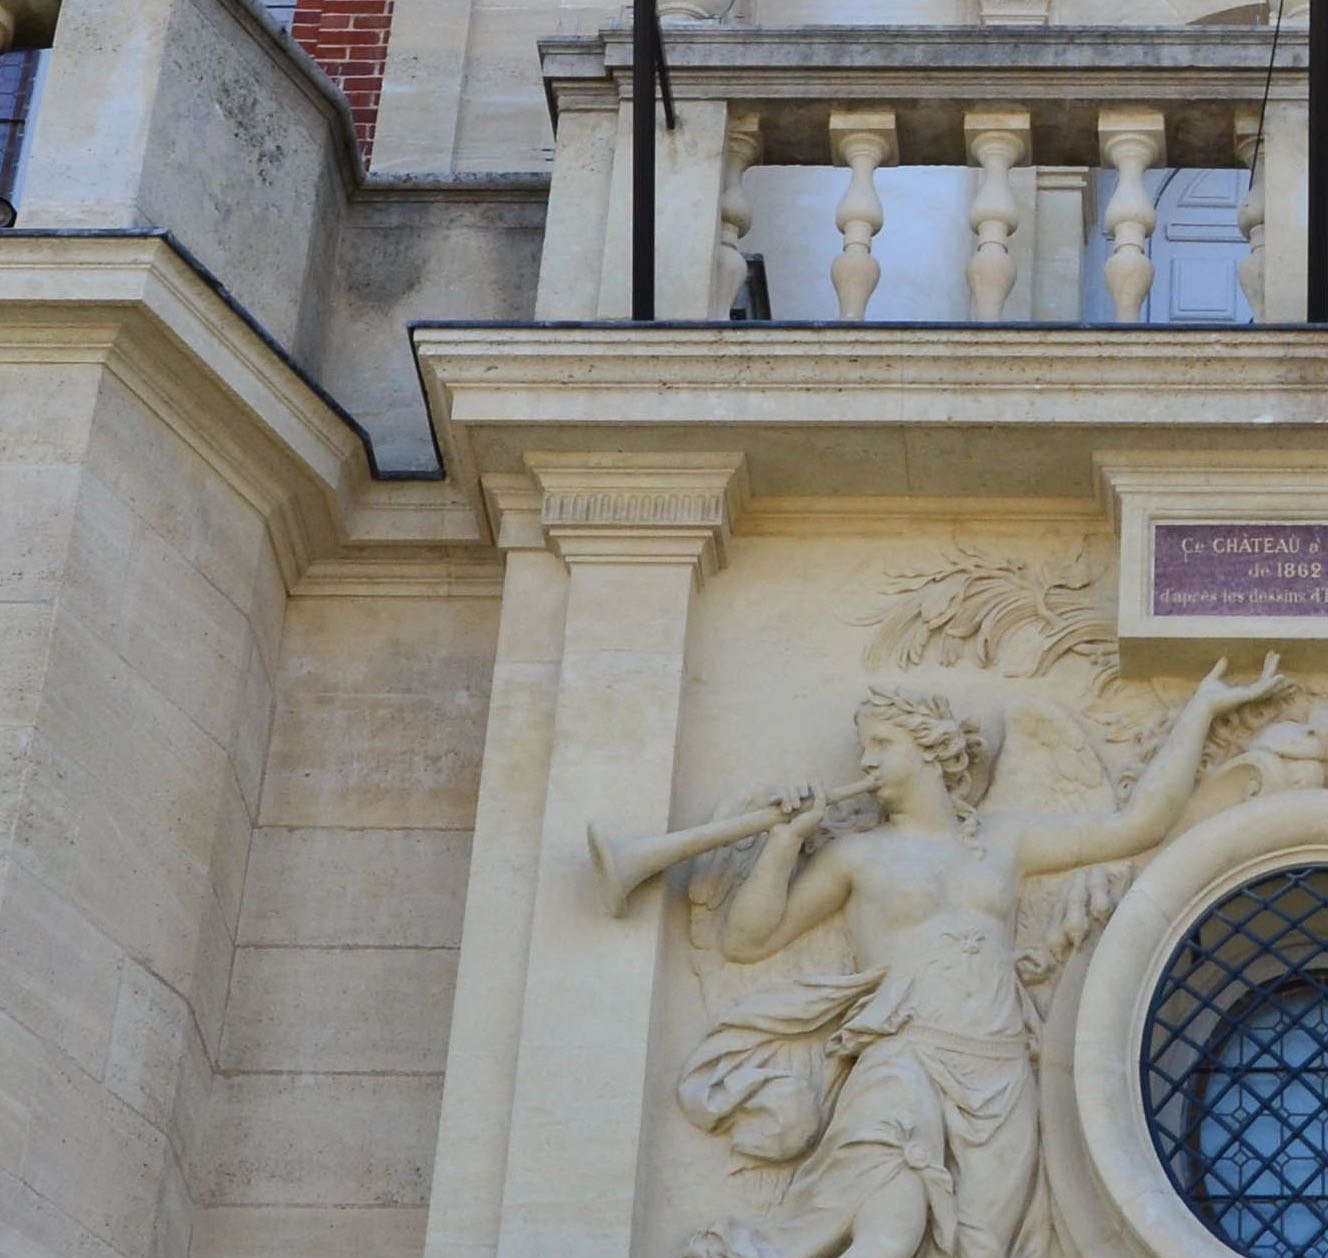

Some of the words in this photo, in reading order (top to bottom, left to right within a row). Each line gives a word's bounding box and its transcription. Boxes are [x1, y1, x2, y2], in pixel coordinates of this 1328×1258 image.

[1212, 533, 1301, 554] CHÂTEAU
[1248, 563, 1270, 578] de
[1277, 562, 1322, 579] 1862
[1160, 587, 1218, 608] d'après
[1223, 589, 1244, 604] les
[1249, 588, 1305, 604] dessins
